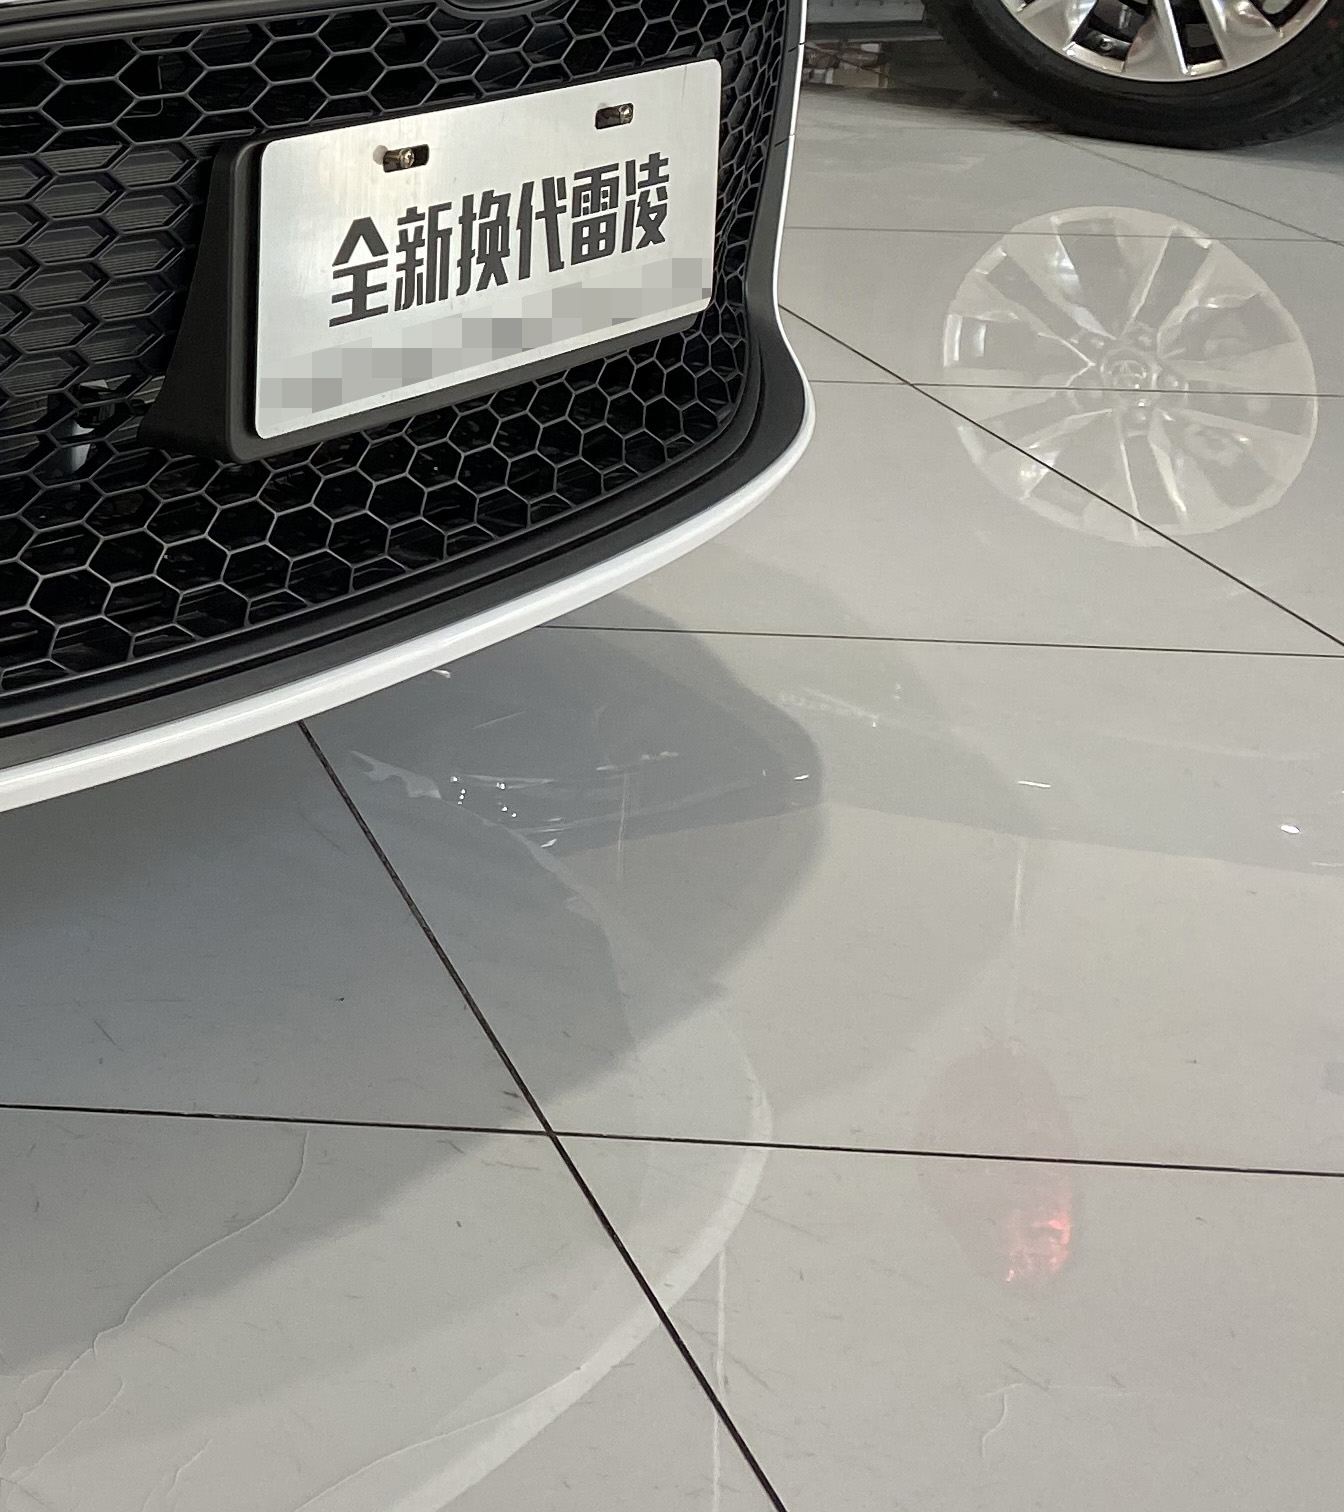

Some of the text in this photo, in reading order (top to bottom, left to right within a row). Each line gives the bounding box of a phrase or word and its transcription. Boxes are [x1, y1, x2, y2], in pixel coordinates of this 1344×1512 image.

[328, 151, 670, 328] 全新换代雷凌
